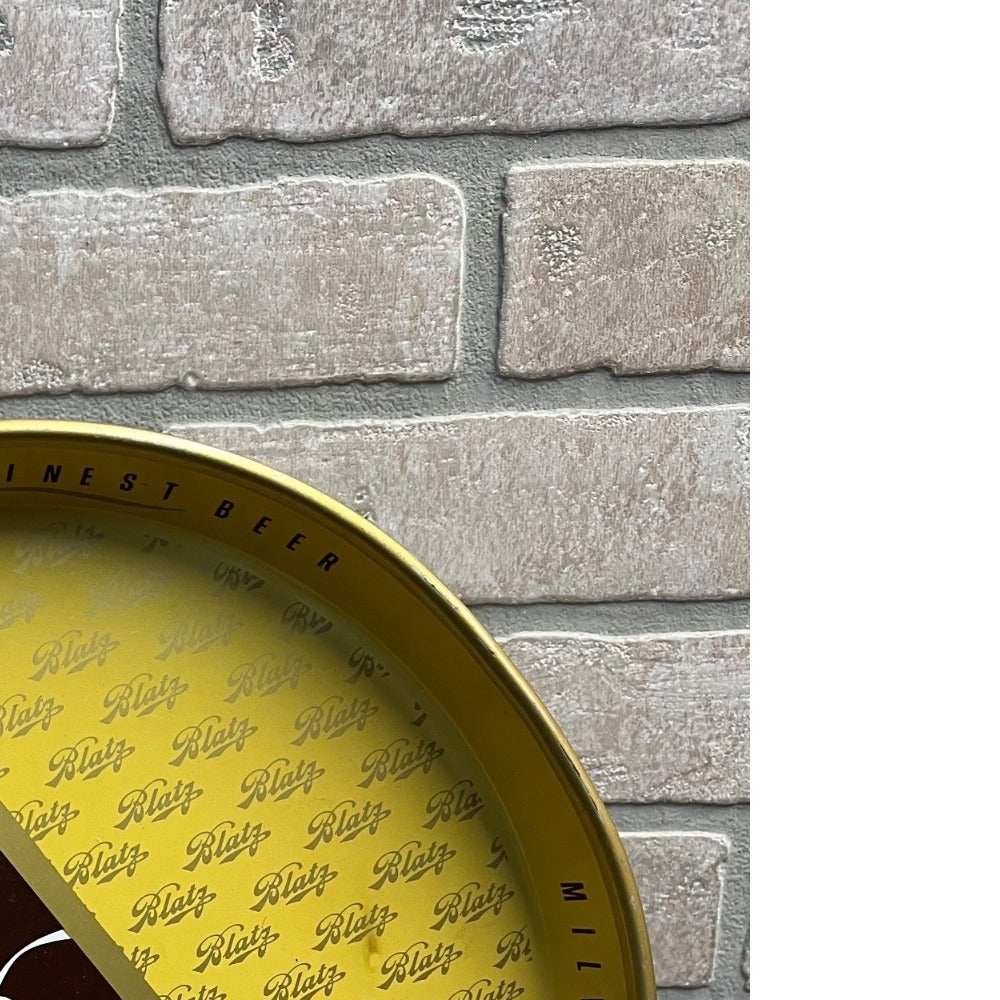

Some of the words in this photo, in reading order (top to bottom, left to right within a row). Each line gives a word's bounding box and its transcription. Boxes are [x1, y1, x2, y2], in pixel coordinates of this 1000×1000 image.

[213, 499, 340, 573] BEER
[29, 630, 119, 682] Blatz
[223, 654, 312, 703] Blatz
[100, 673, 189, 724] Blatz
[290, 695, 379, 746] Blatz
[45, 737, 135, 788] Blatz
[169, 718, 257, 767] Blatz
[357, 738, 445, 788] Blatz
[114, 779, 203, 830] Blatz
[237, 760, 325, 809] Blatz
[422, 779, 486, 829] Bla
[182, 821, 271, 872] Blatz
[303, 800, 391, 850] Blatz
[64, 841, 149, 885] Blatz
[249, 862, 338, 912] Blatz
[368, 842, 456, 891] Blatz
[128, 883, 217, 933] Blatz
[311, 903, 398, 954] Blatz
[430, 883, 515, 931] Blatz
[192, 924, 280, 973] Blatz
[377, 941, 463, 990] Blatz
